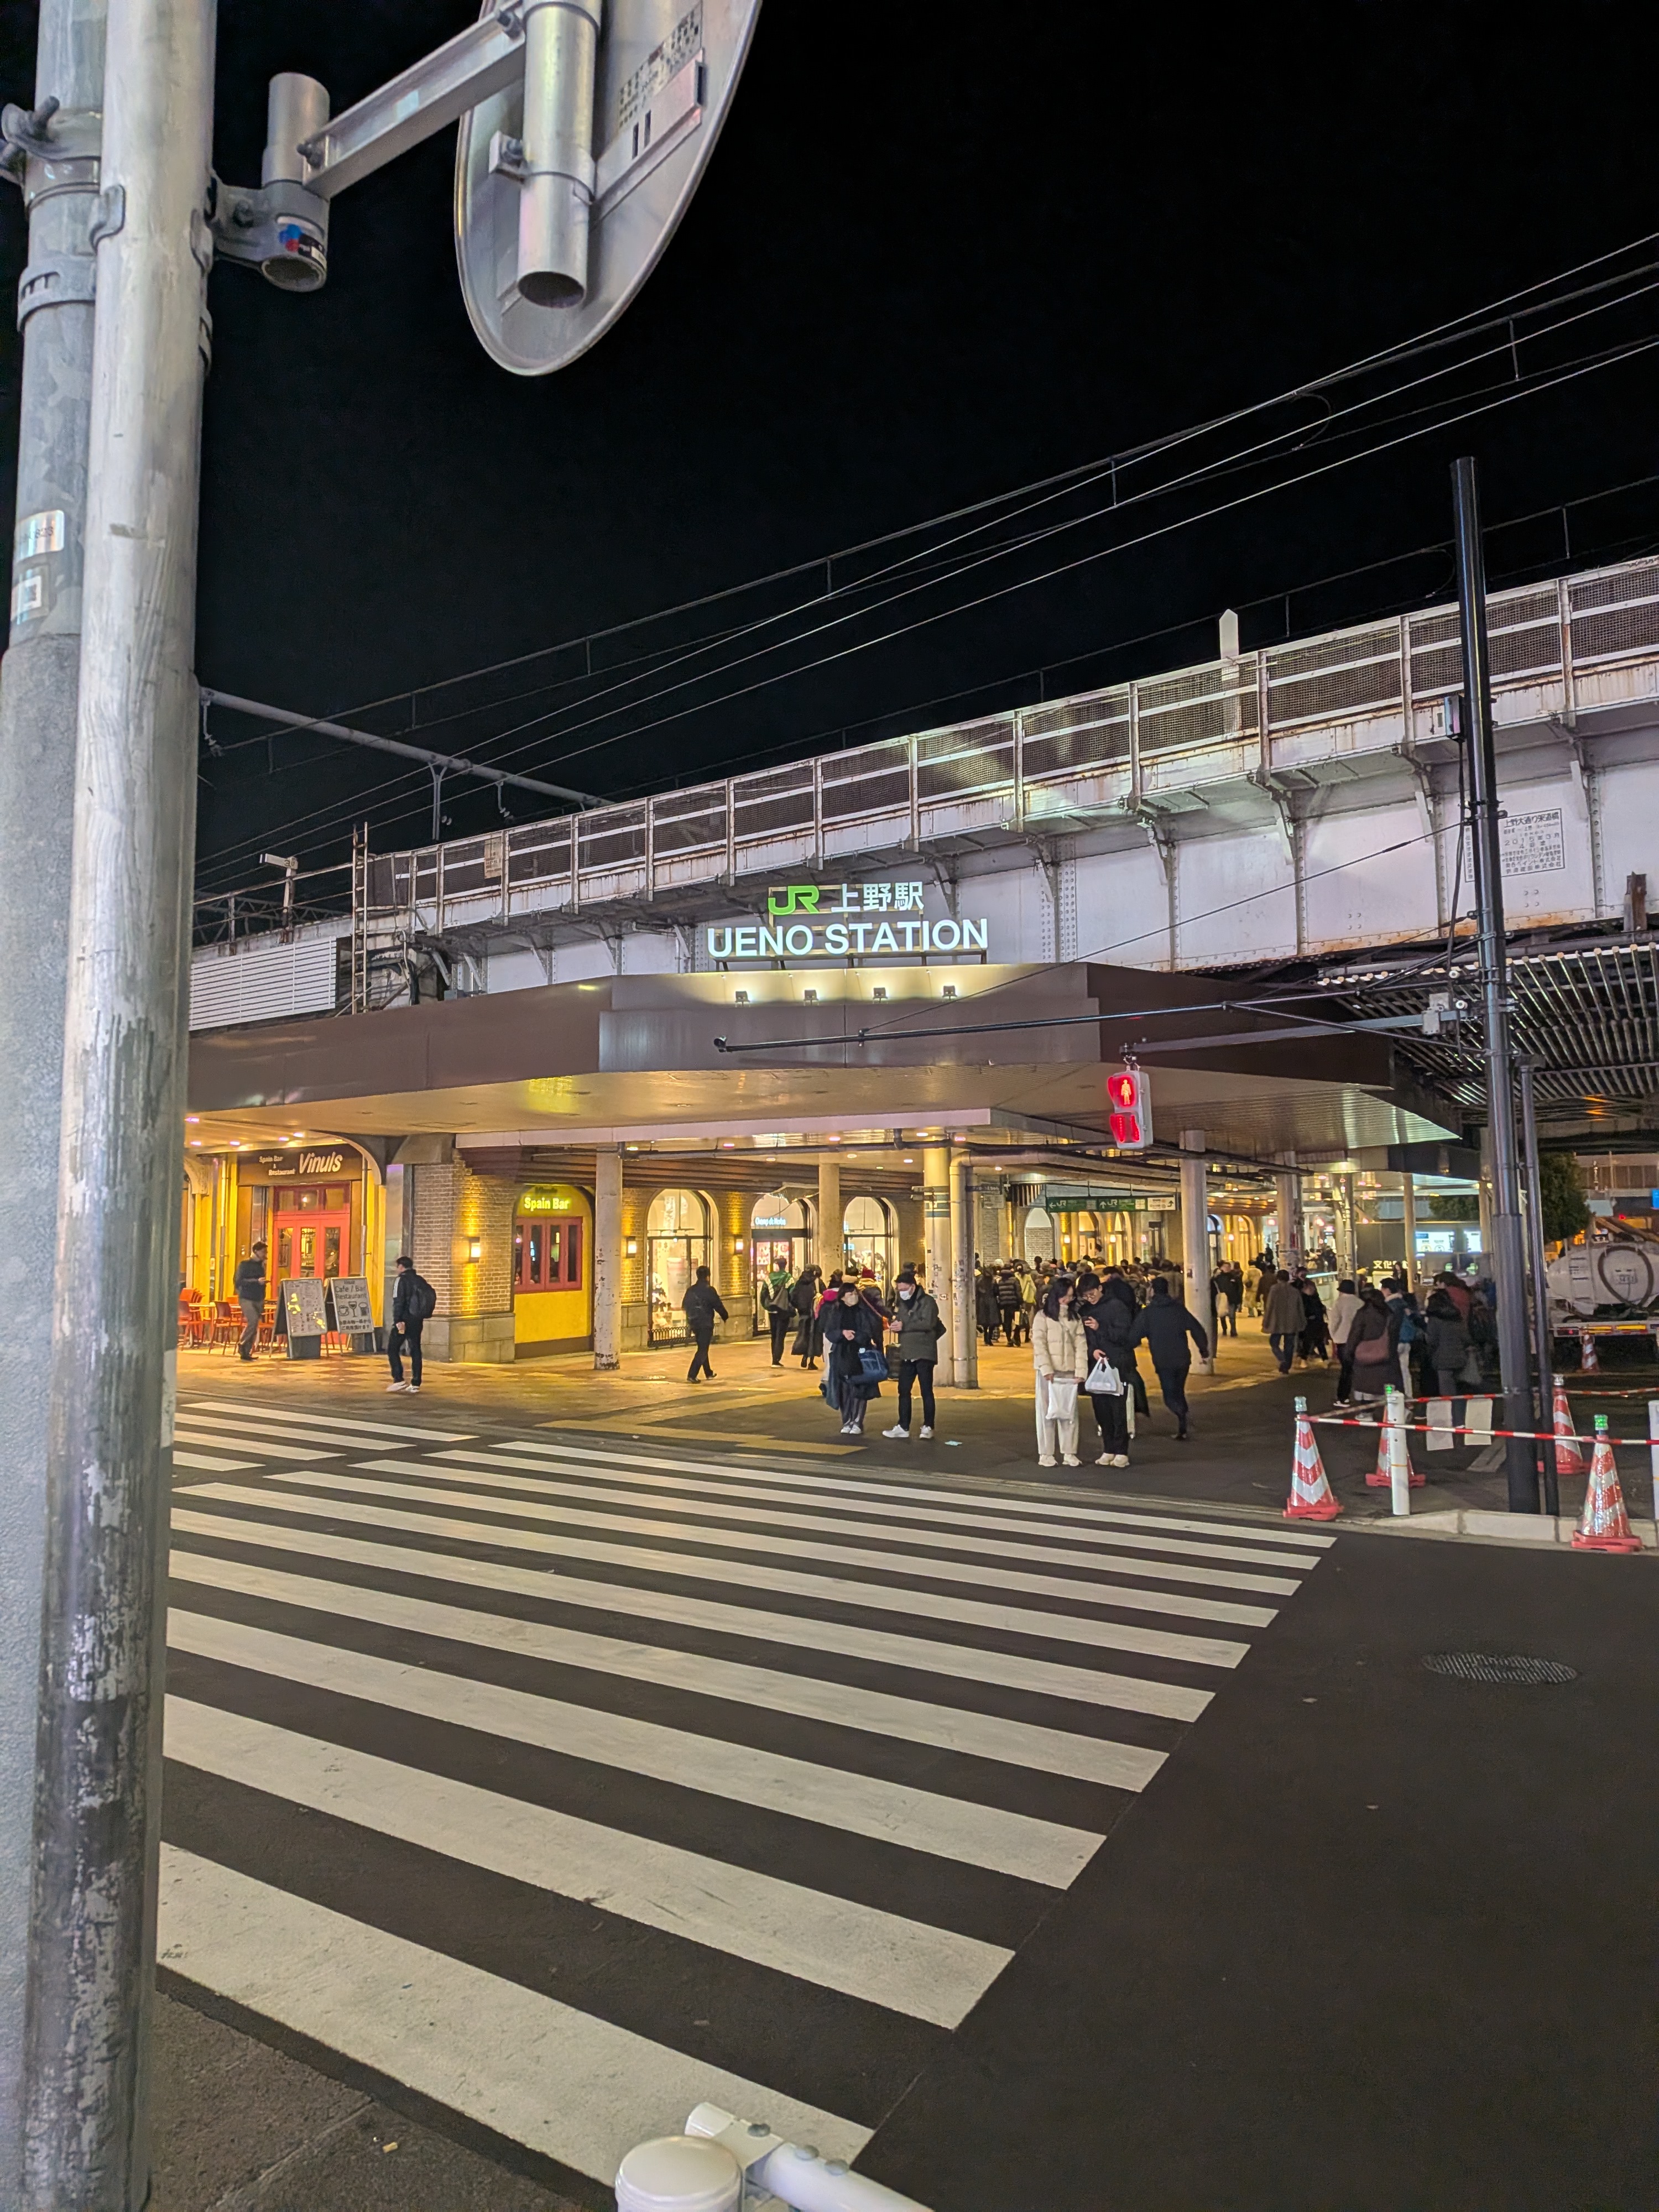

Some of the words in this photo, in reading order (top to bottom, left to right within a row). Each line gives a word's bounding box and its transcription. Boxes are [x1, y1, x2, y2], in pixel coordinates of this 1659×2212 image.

[768, 885, 820, 915] JR
[831, 881, 925, 912] 上野駅
[708, 924, 813, 958] UENO
[825, 918, 989, 956] STATION
[299, 1151, 343, 1173] Vinuls
[524, 1197, 551, 1212] Spain
[552, 1198, 570, 1209] Bar
